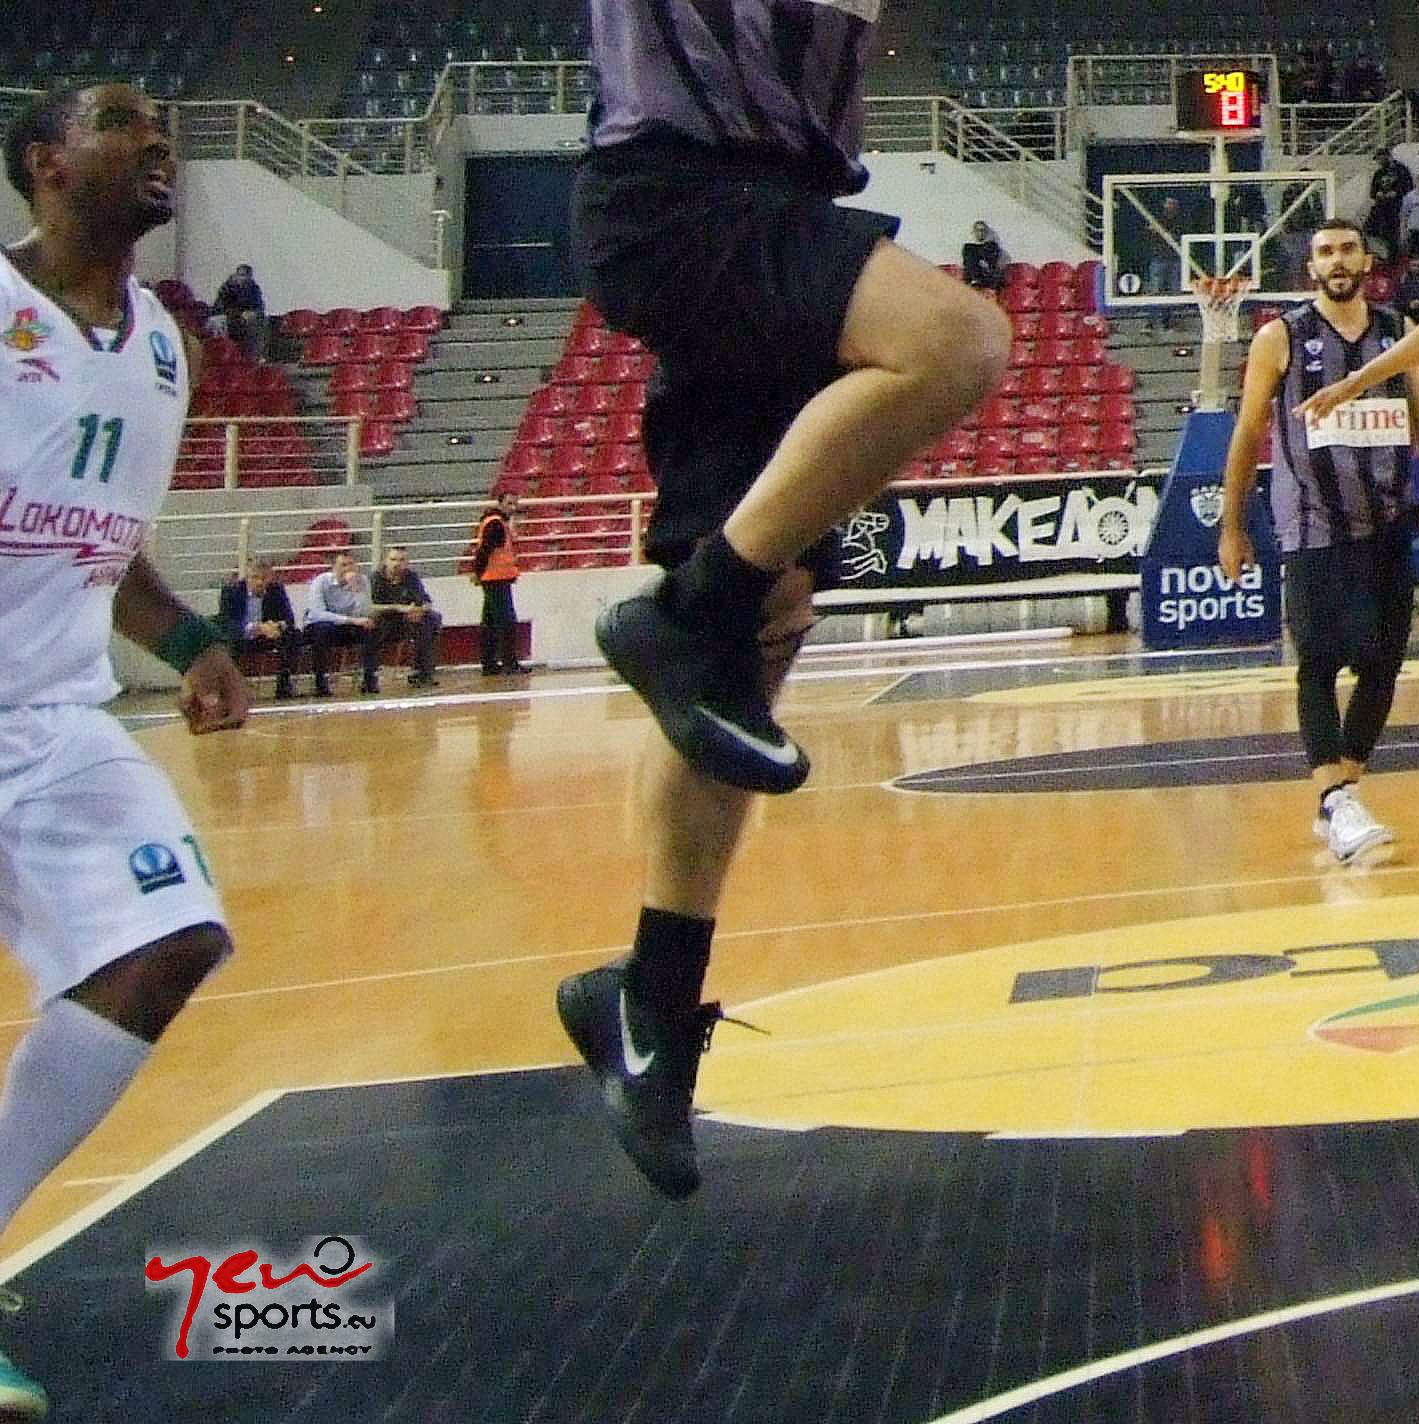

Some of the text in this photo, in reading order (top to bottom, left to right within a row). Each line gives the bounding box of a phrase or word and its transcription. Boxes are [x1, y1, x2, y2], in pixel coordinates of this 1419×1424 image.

[1310, 401, 1406, 431] rime
[70, 413, 126, 484] 11
[1159, 563, 1264, 596] nova
[1159, 591, 1266, 630] sports
